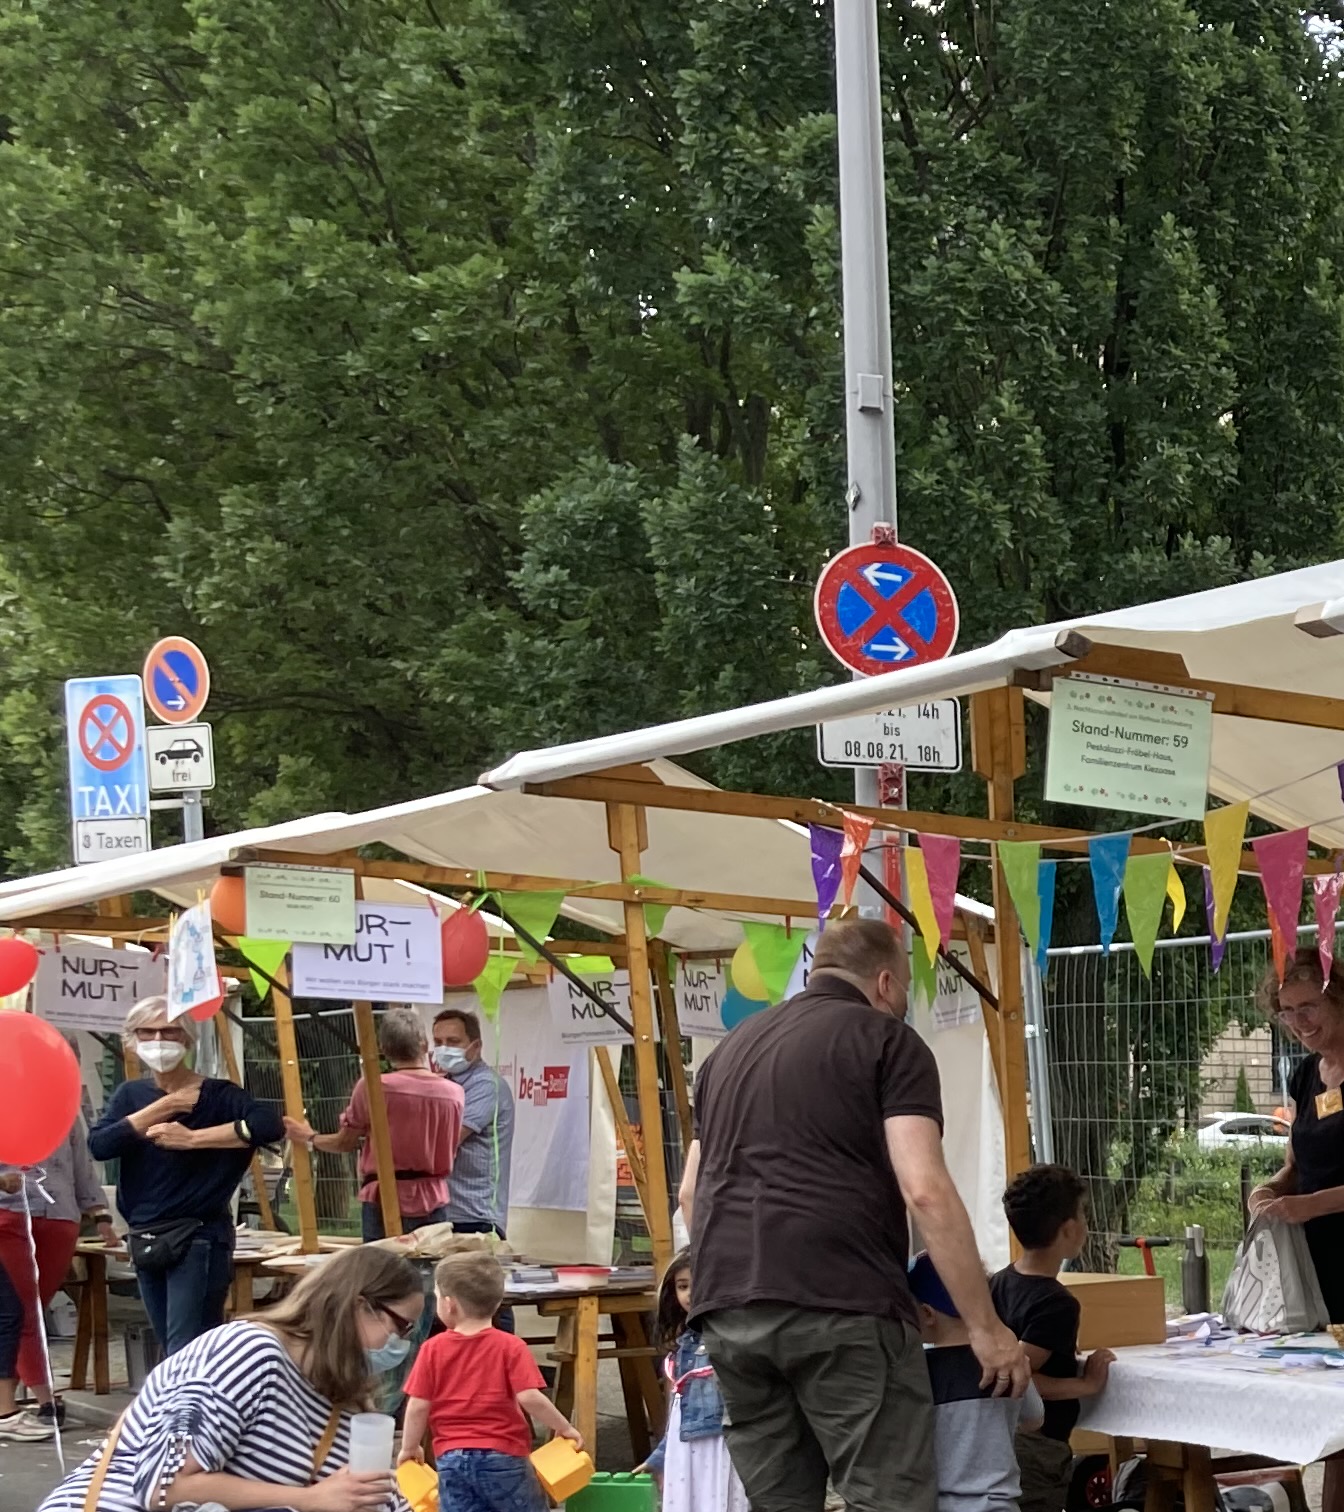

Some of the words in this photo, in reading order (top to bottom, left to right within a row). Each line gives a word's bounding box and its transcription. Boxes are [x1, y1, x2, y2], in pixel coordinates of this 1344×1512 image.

[918, 703, 940, 720] 14h
[883, 723, 901, 737] bis
[1071, 719, 1170, 746] Stand-Nummer:
[1173, 734, 1189, 749] 59
[845, 740, 908, 762] 08.08.21.
[917, 744, 941, 763] 18h
[172, 768, 192, 783] frei
[77, 783, 142, 817] TAXI
[96, 832, 143, 850] Taxen
[61, 955, 140, 979] NUR-
[61, 978, 124, 1002] MUT
[683, 969, 717, 990] NUR-
[684, 991, 711, 1013] MUT
